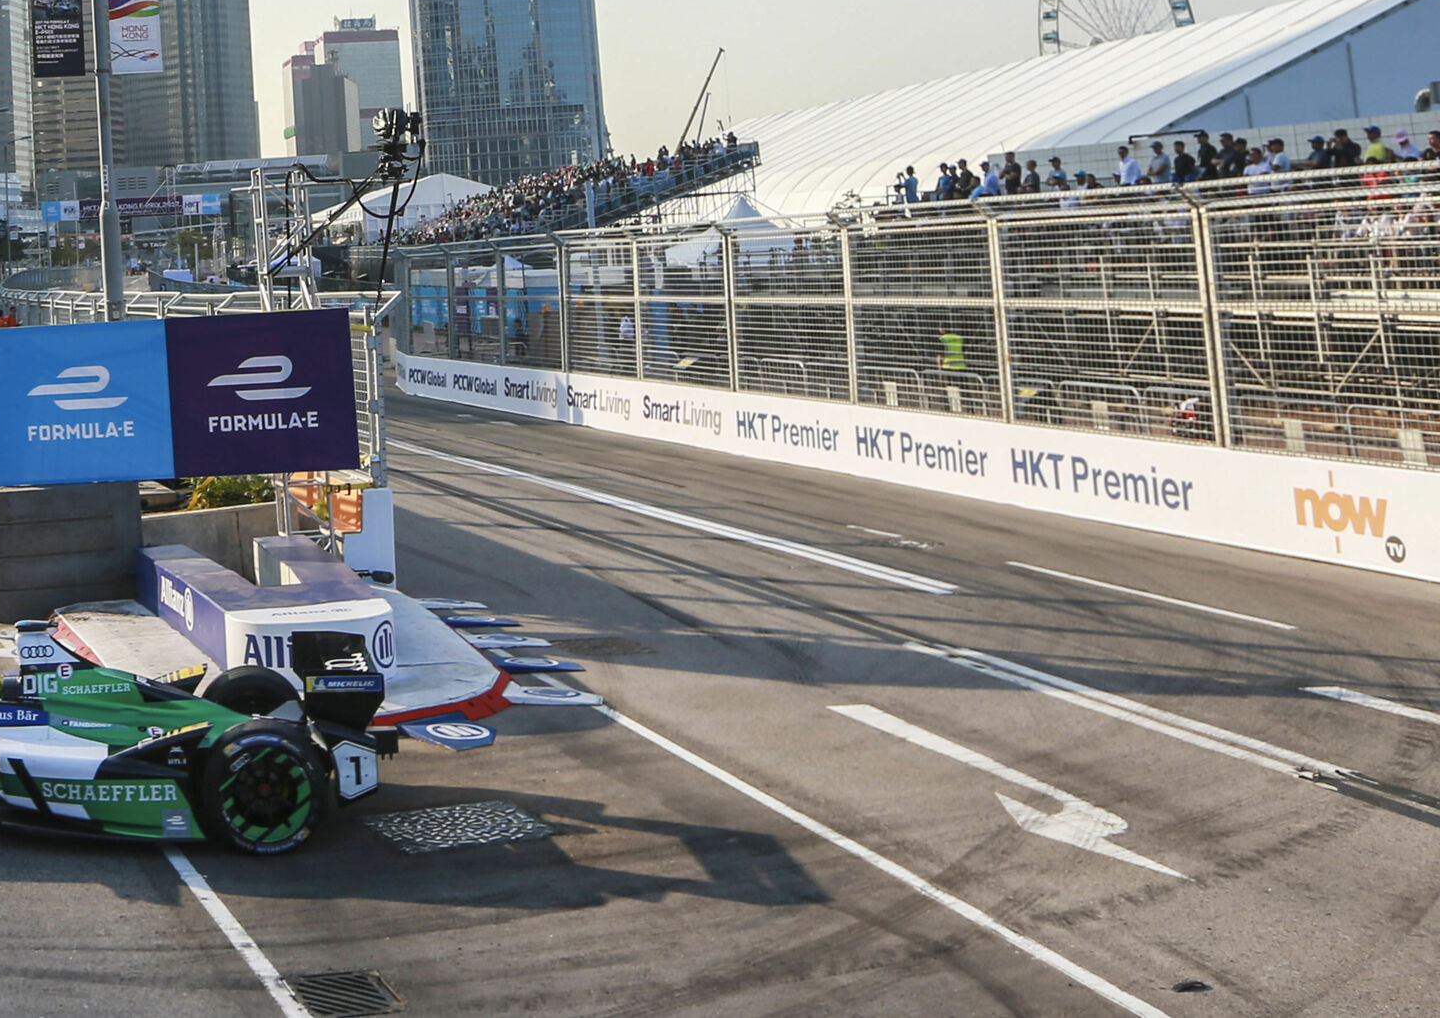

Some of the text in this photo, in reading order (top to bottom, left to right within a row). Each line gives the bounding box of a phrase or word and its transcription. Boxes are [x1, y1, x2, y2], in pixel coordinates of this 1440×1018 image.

[408, 368, 427, 385] PCCW
[427, 370, 447, 388] Global
[452, 373, 474, 392] PCCW
[474, 376, 498, 396] Global
[503, 377, 530, 400] Smart
[530, 380, 558, 405] Living
[566, 385, 598, 410] Smart
[598, 386, 631, 421] Living
[642, 395, 680, 424] Smart
[682, 398, 722, 436] Living
[736, 410, 768, 442] HKT
[770, 412, 840, 453] Premier
[855, 426, 896, 462] HKT
[899, 429, 988, 477] Premier
[1011, 447, 1065, 491] HKT
[1071, 456, 1193, 512] Premier
[1293, 486, 1388, 539] now
[1387, 538, 1405, 559] TV
[160, 575, 185, 618] Allianz
[61, 665, 71, 678] E
[23, 674, 58, 695] DIG
[62, 683, 131, 695] SCHAEFFLER
[327, 680, 375, 688] MICHELIN
[16, 708, 39, 722] Bär
[349, 756, 363, 786] 1
[42, 782, 178, 802] SCHAEFFLER
